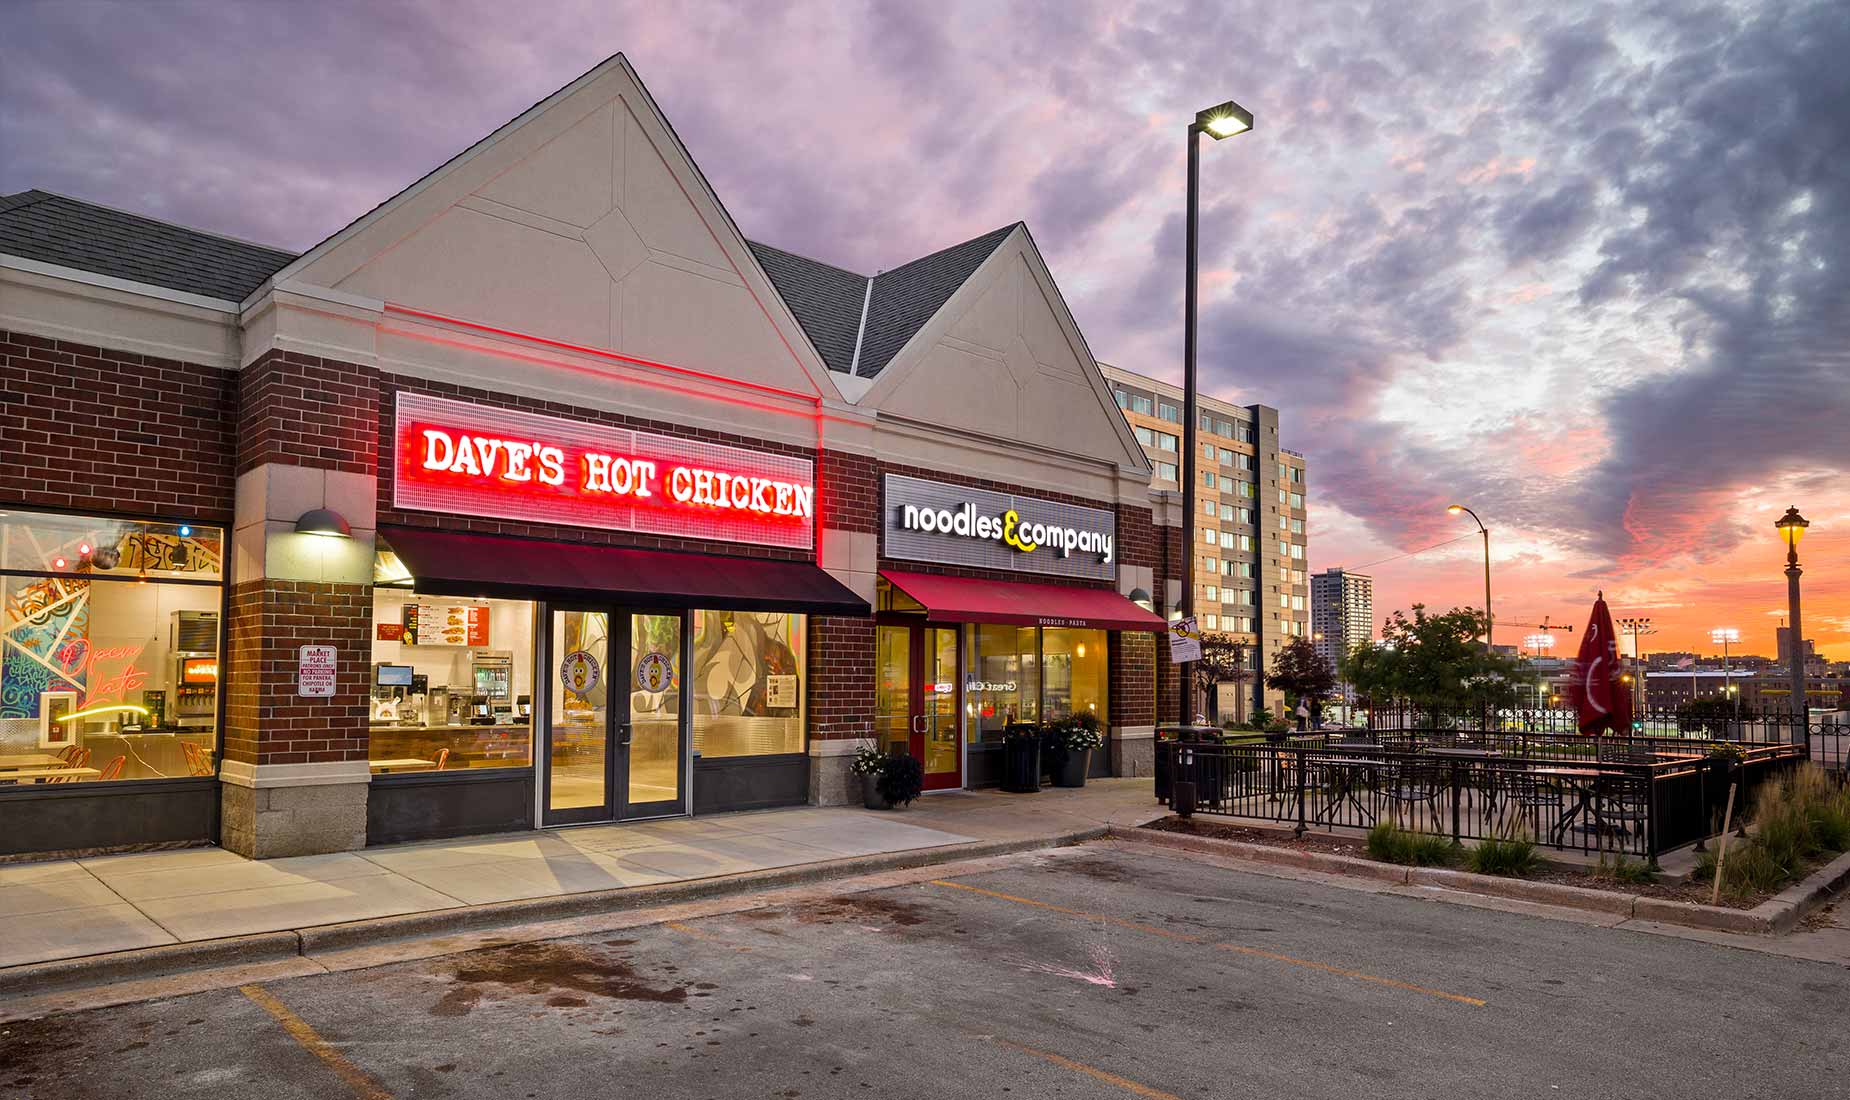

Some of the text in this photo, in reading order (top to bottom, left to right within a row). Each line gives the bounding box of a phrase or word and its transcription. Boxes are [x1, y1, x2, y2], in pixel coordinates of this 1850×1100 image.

[422, 430, 813, 518] DAVE'S HOT CHICKEN
[1039, 618, 1065, 626] NOODLES
[62, 638, 144, 677] Open
[78, 664, 149, 710] Late
